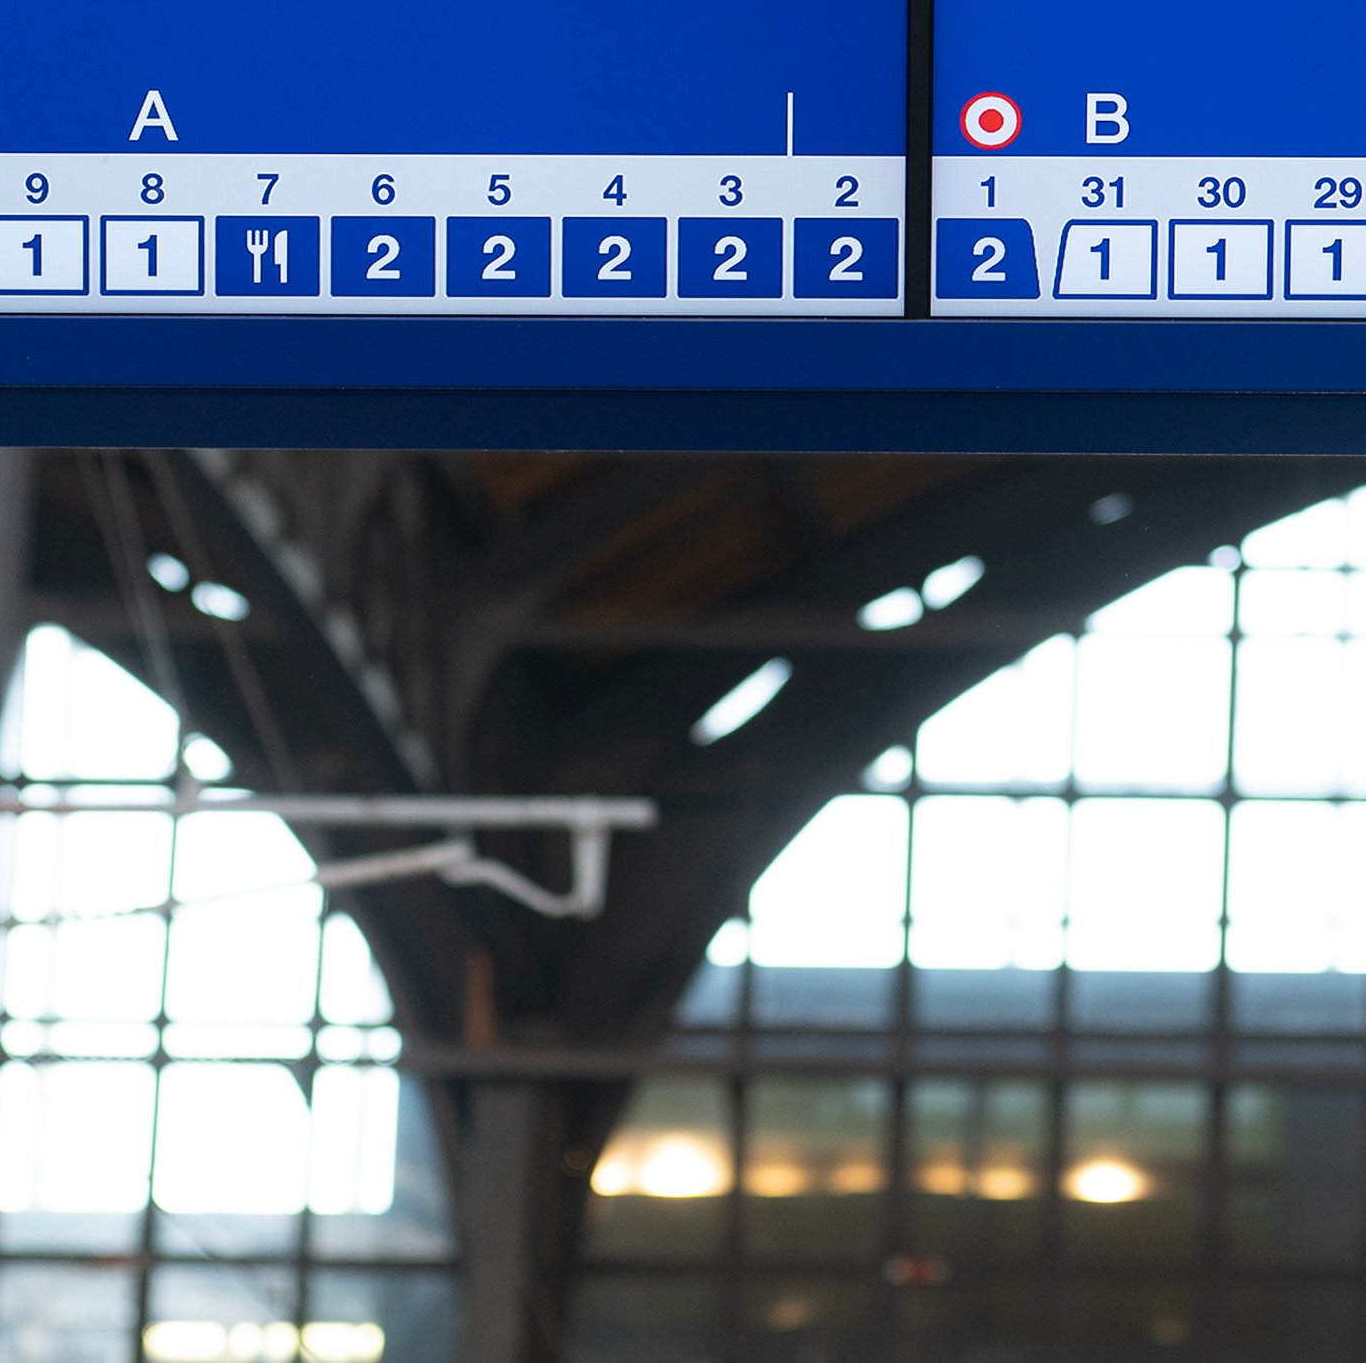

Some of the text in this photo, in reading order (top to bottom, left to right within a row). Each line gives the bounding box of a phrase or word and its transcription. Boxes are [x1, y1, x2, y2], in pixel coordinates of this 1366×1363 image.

[129, 90, 179, 141] A
[1086, 92, 1130, 144] B
[23, 172, 51, 205] 9
[139, 172, 166, 205] 8
[255, 173, 281, 206] 7
[370, 173, 397, 206] 6
[486, 173, 513, 206] 5
[601, 174, 629, 207] 4
[717, 174, 744, 207] 3
[833, 175, 860, 208] 2
[979, 175, 997, 208] 1
[1080, 176, 1125, 209] 31
[1196, 176, 1248, 209] 30
[1312, 176, 1364, 209] 29
[20, 233, 44, 277] 1
[136, 234, 159, 277] 1
[365, 234, 402, 280] 2
[480, 235, 517, 280] 2
[596, 235, 633, 280] 2
[712, 236, 749, 281] 2
[827, 236, 864, 281] 2
[970, 237, 1007, 282] 2
[1088, 237, 1112, 281] 1
[1205, 238, 1228, 281] 1
[1321, 238, 1344, 282] 1
